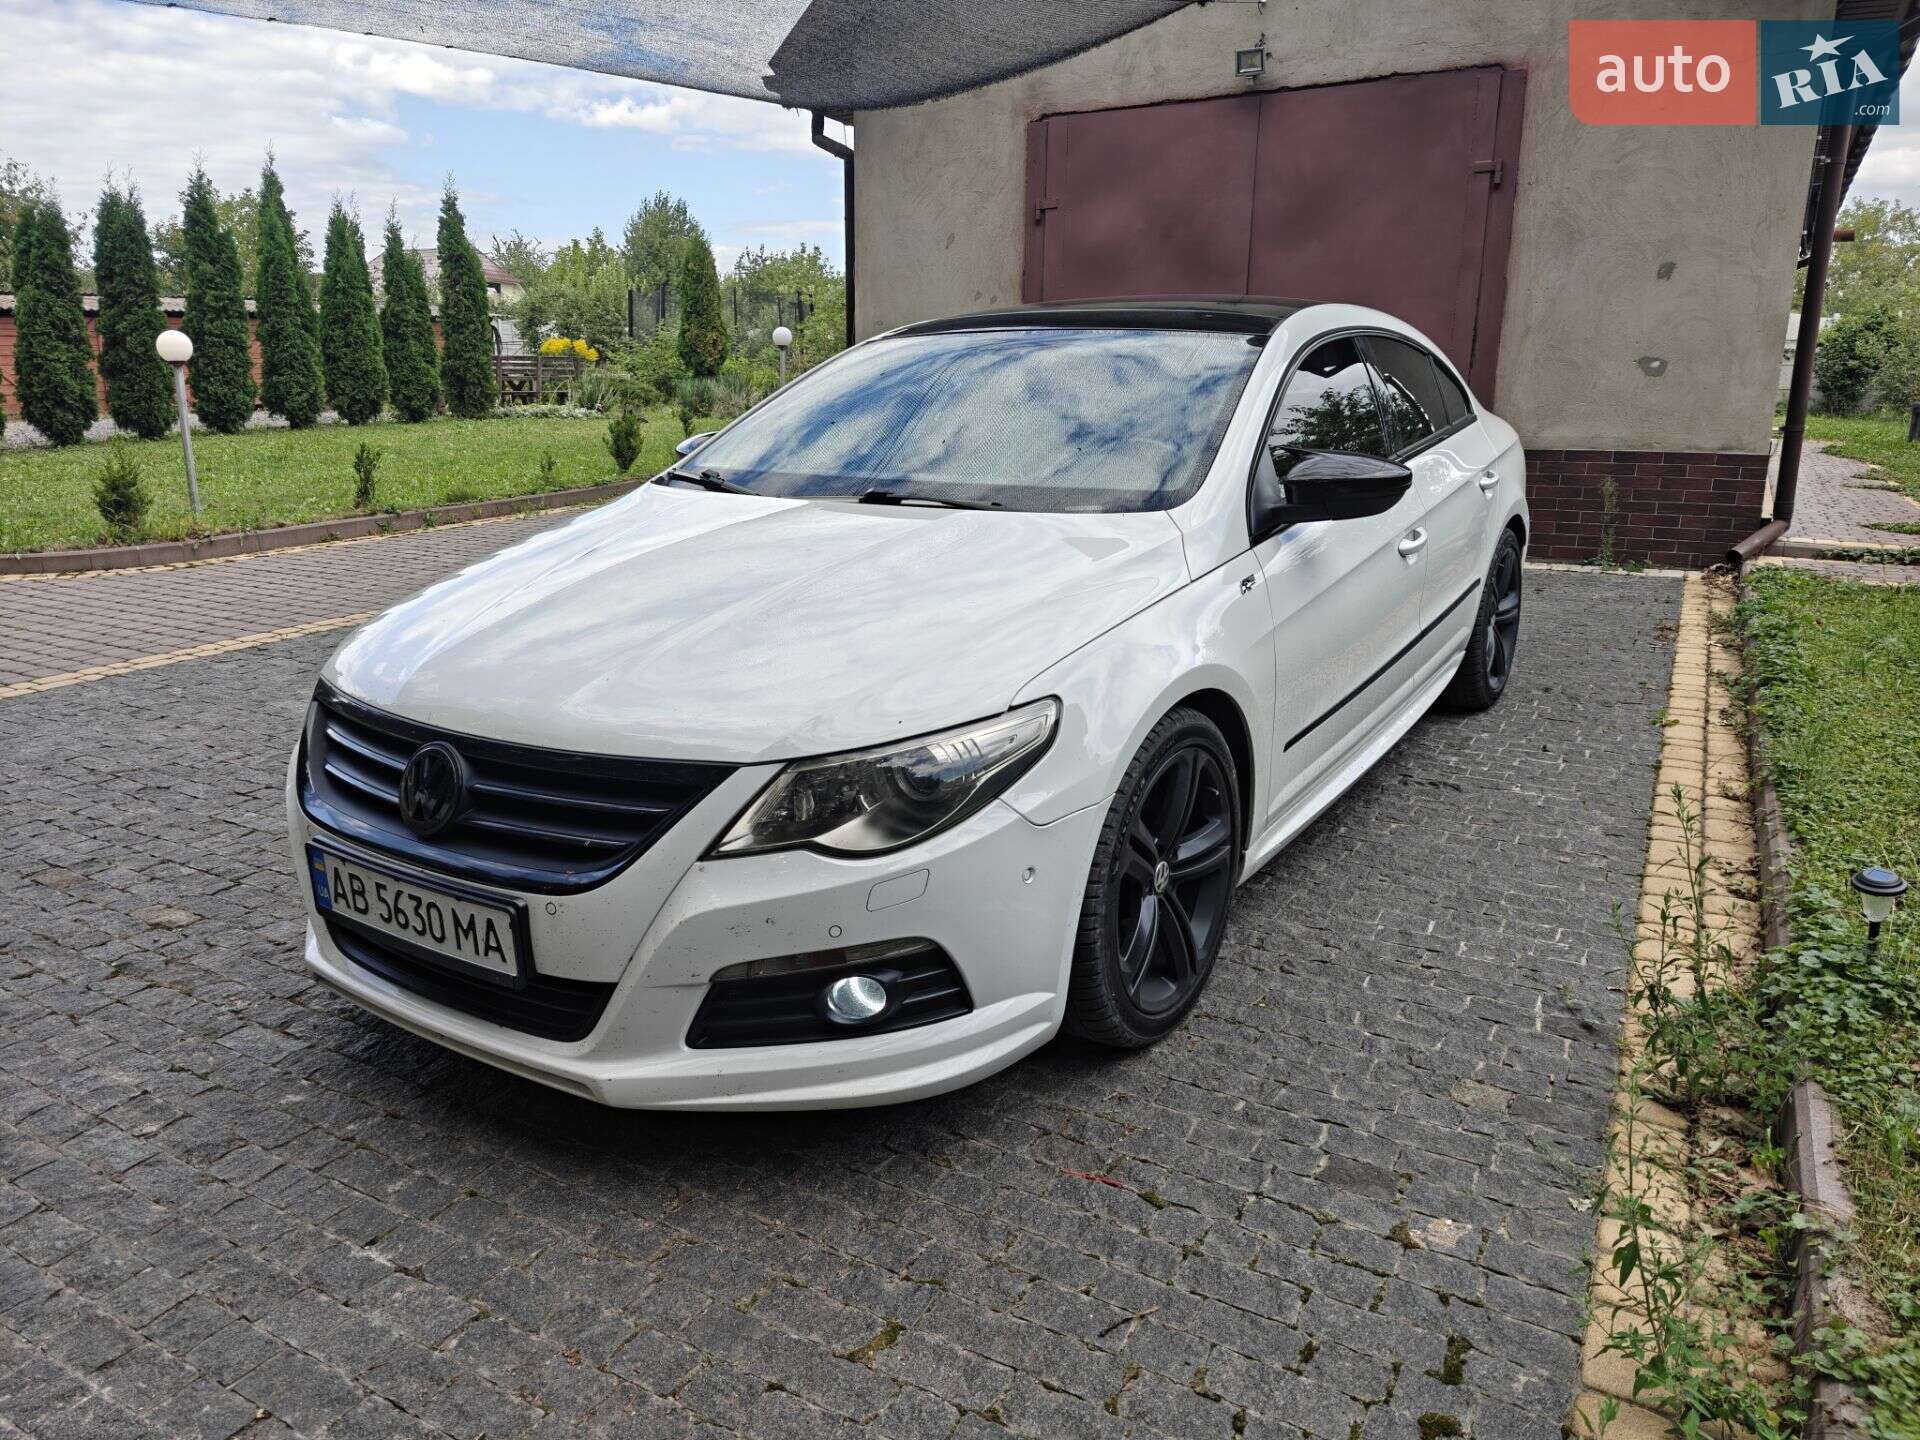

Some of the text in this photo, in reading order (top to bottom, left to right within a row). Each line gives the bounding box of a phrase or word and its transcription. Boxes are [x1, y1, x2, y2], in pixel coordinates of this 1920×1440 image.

[333, 866, 507, 963] AB 5630 MA
